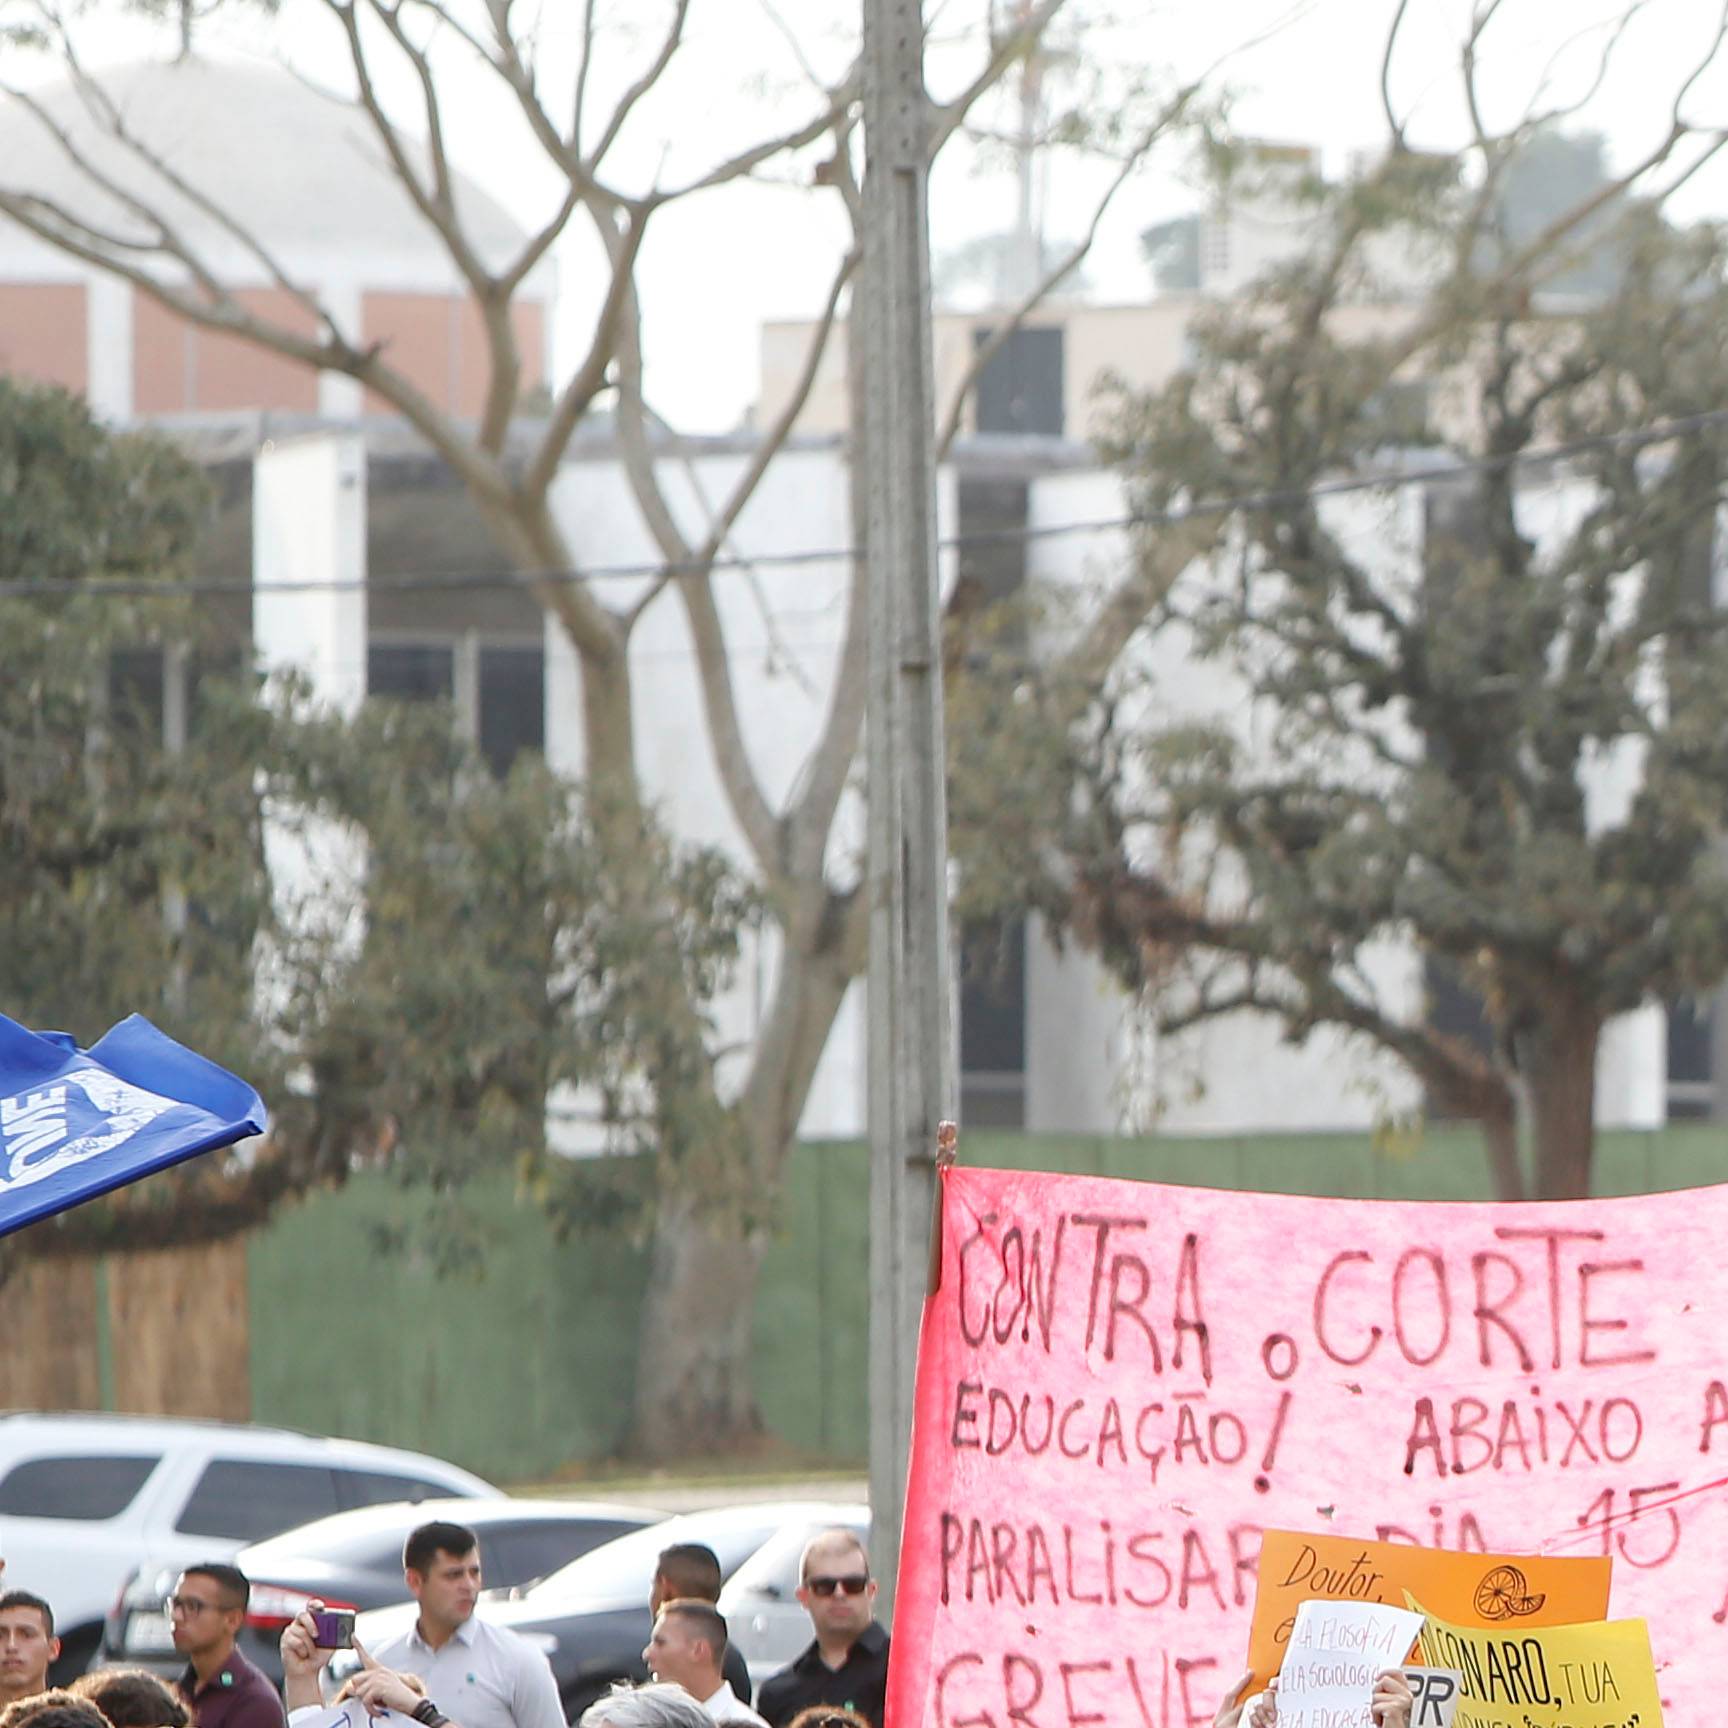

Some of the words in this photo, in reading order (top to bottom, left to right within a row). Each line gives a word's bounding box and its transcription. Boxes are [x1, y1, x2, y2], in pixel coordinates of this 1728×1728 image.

[957, 1211, 1213, 1389] CONTRA
[1262, 1333, 1299, 1381] o
[1313, 1226, 1657, 1372] CORTE
[951, 1381, 1292, 1493] EDUCAÇÃO!
[1576, 1480, 1683, 1570] 15
[1276, 1543, 1385, 1600] Doutor,
[1558, 1660, 1622, 1705] TUA
